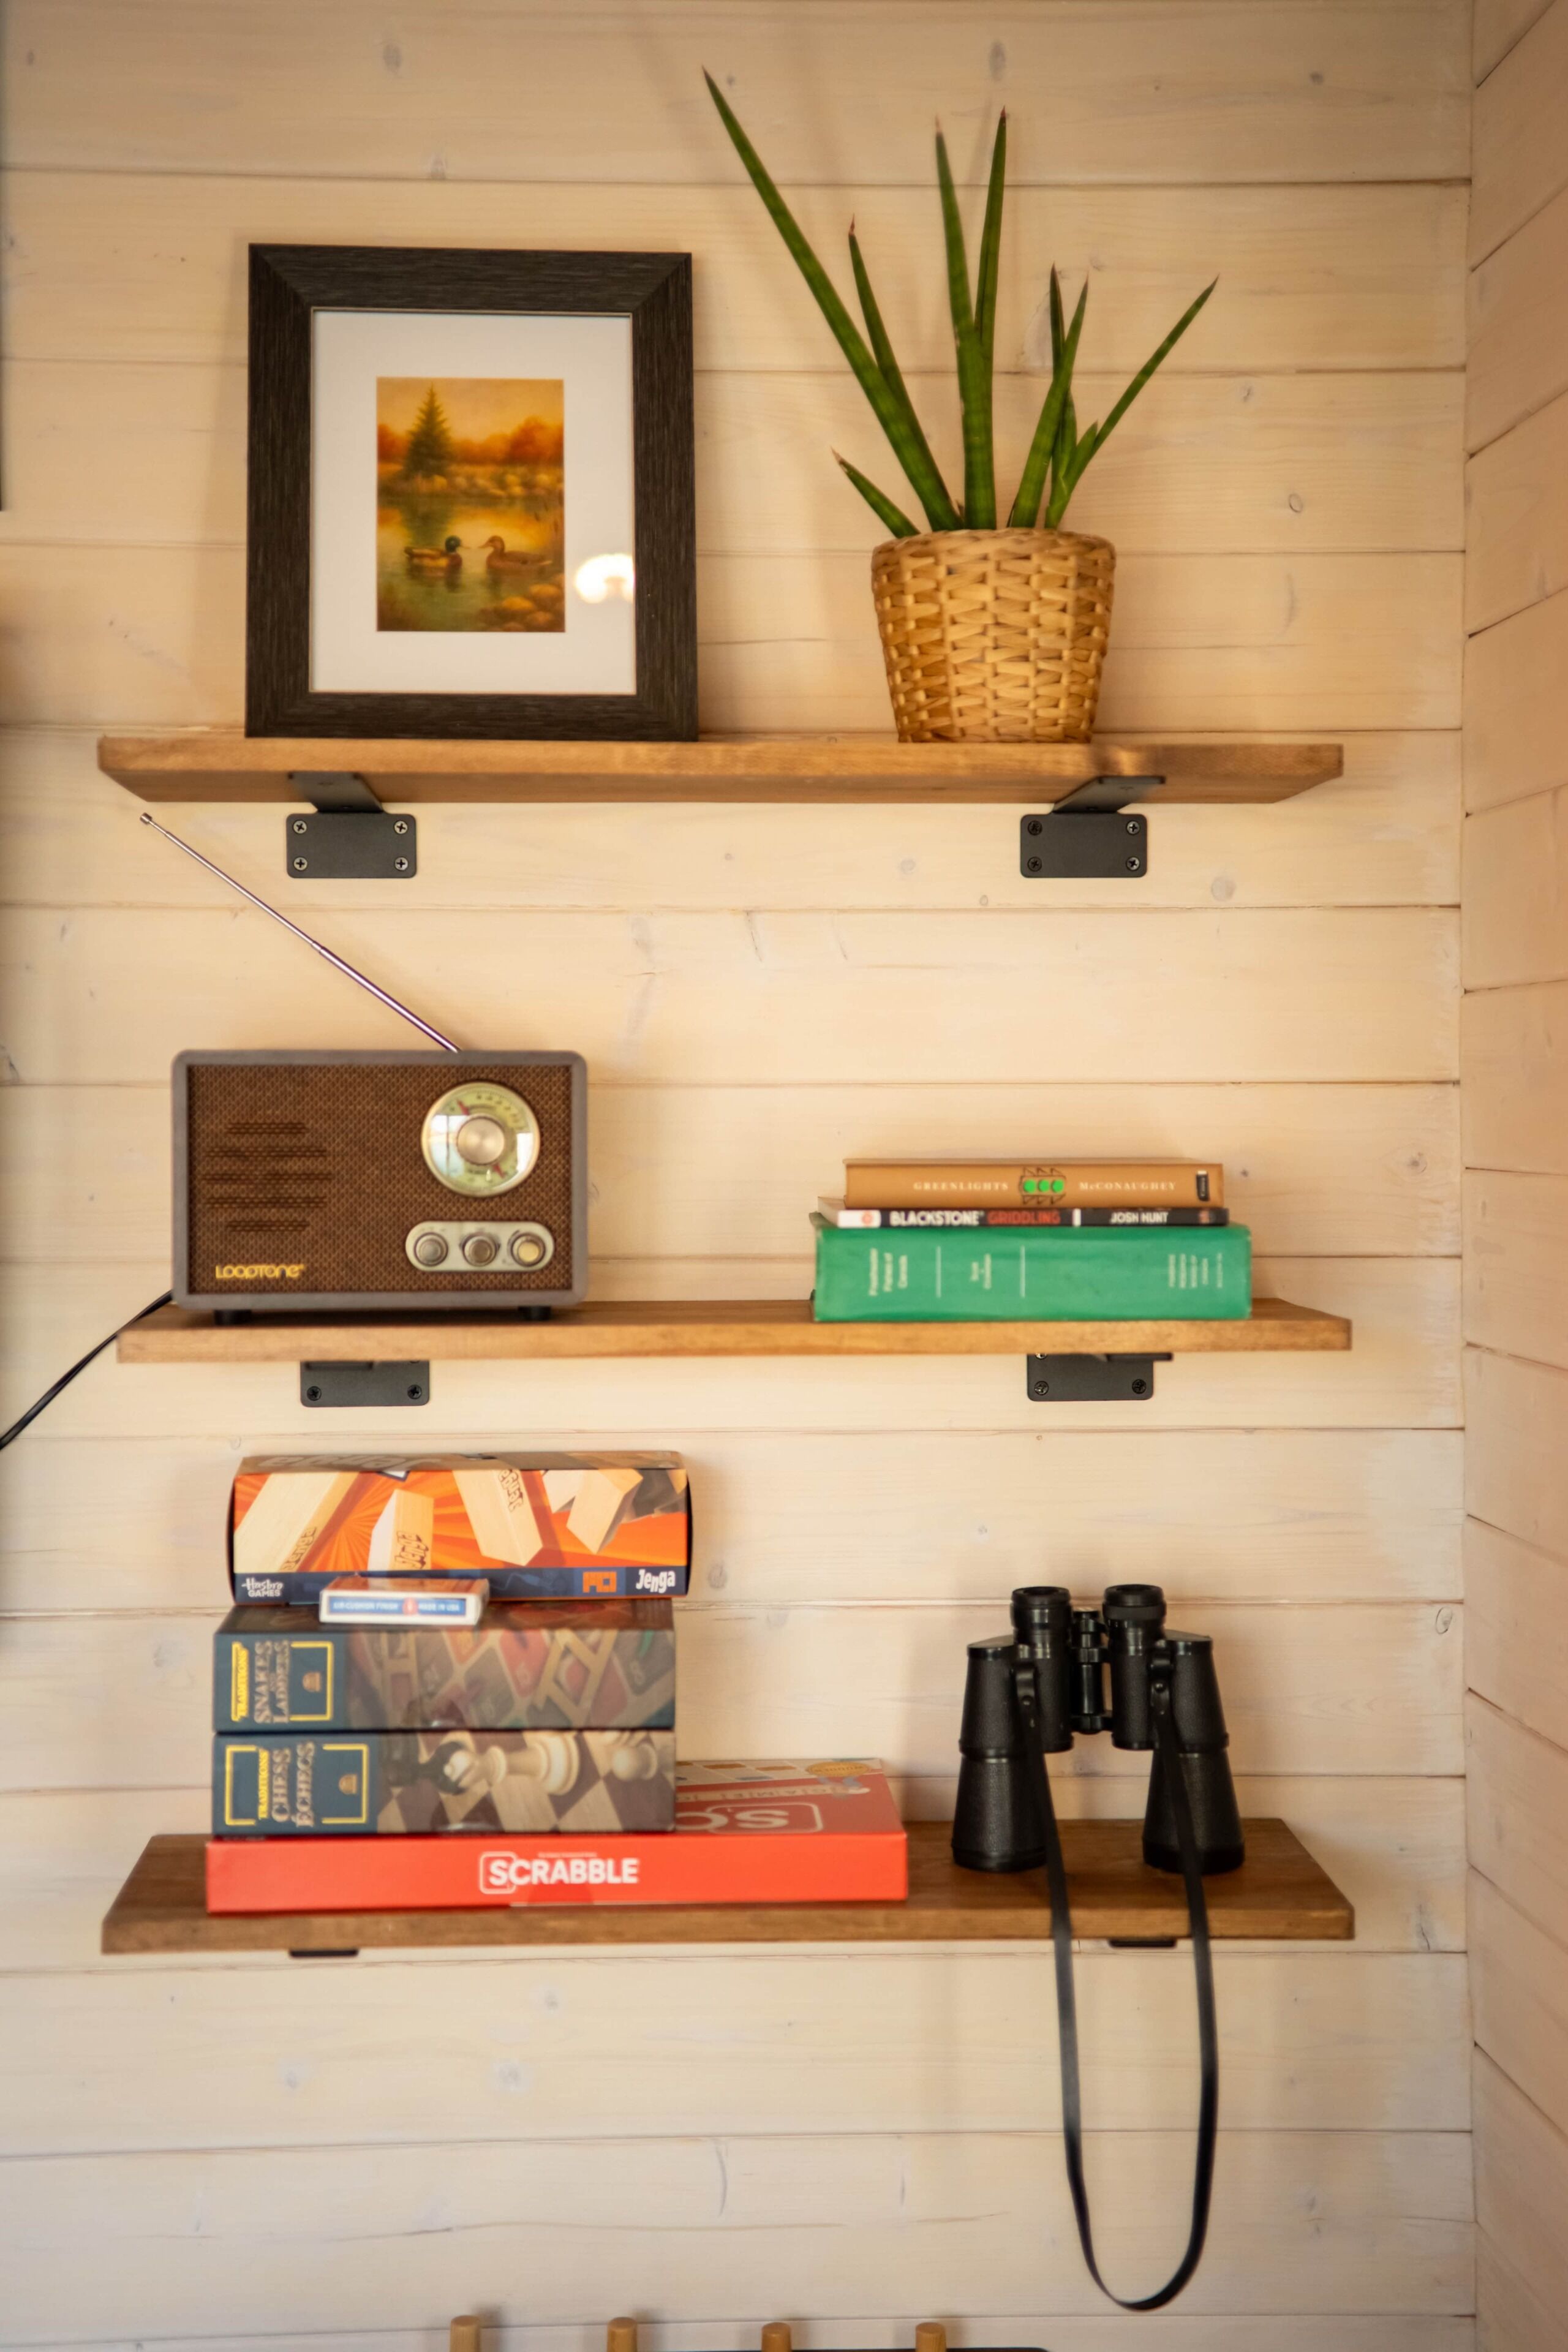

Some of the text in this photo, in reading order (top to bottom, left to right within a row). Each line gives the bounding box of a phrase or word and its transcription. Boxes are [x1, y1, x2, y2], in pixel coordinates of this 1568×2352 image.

[913, 1182, 1009, 1191] GREENLIGHTS
[889, 1210, 1169, 1226] BLACKSTONE GRIDDLING JOSH HUNT
[394, 1531, 429, 1569] Jenga
[241, 1577, 284, 1591] Hasbro
[635, 1569, 676, 1594] Jenga
[237, 1646, 249, 1717] TRADITIONS
[254, 1640, 273, 1724] SNAKES
[273, 1640, 290, 1724] LADDERS
[258, 1748, 269, 1820] TRADITIONS
[271, 1747, 292, 1823] CHESS
[291, 1741, 315, 1828] ÉCHECS
[488, 1858, 639, 1886] SCRABBLE
